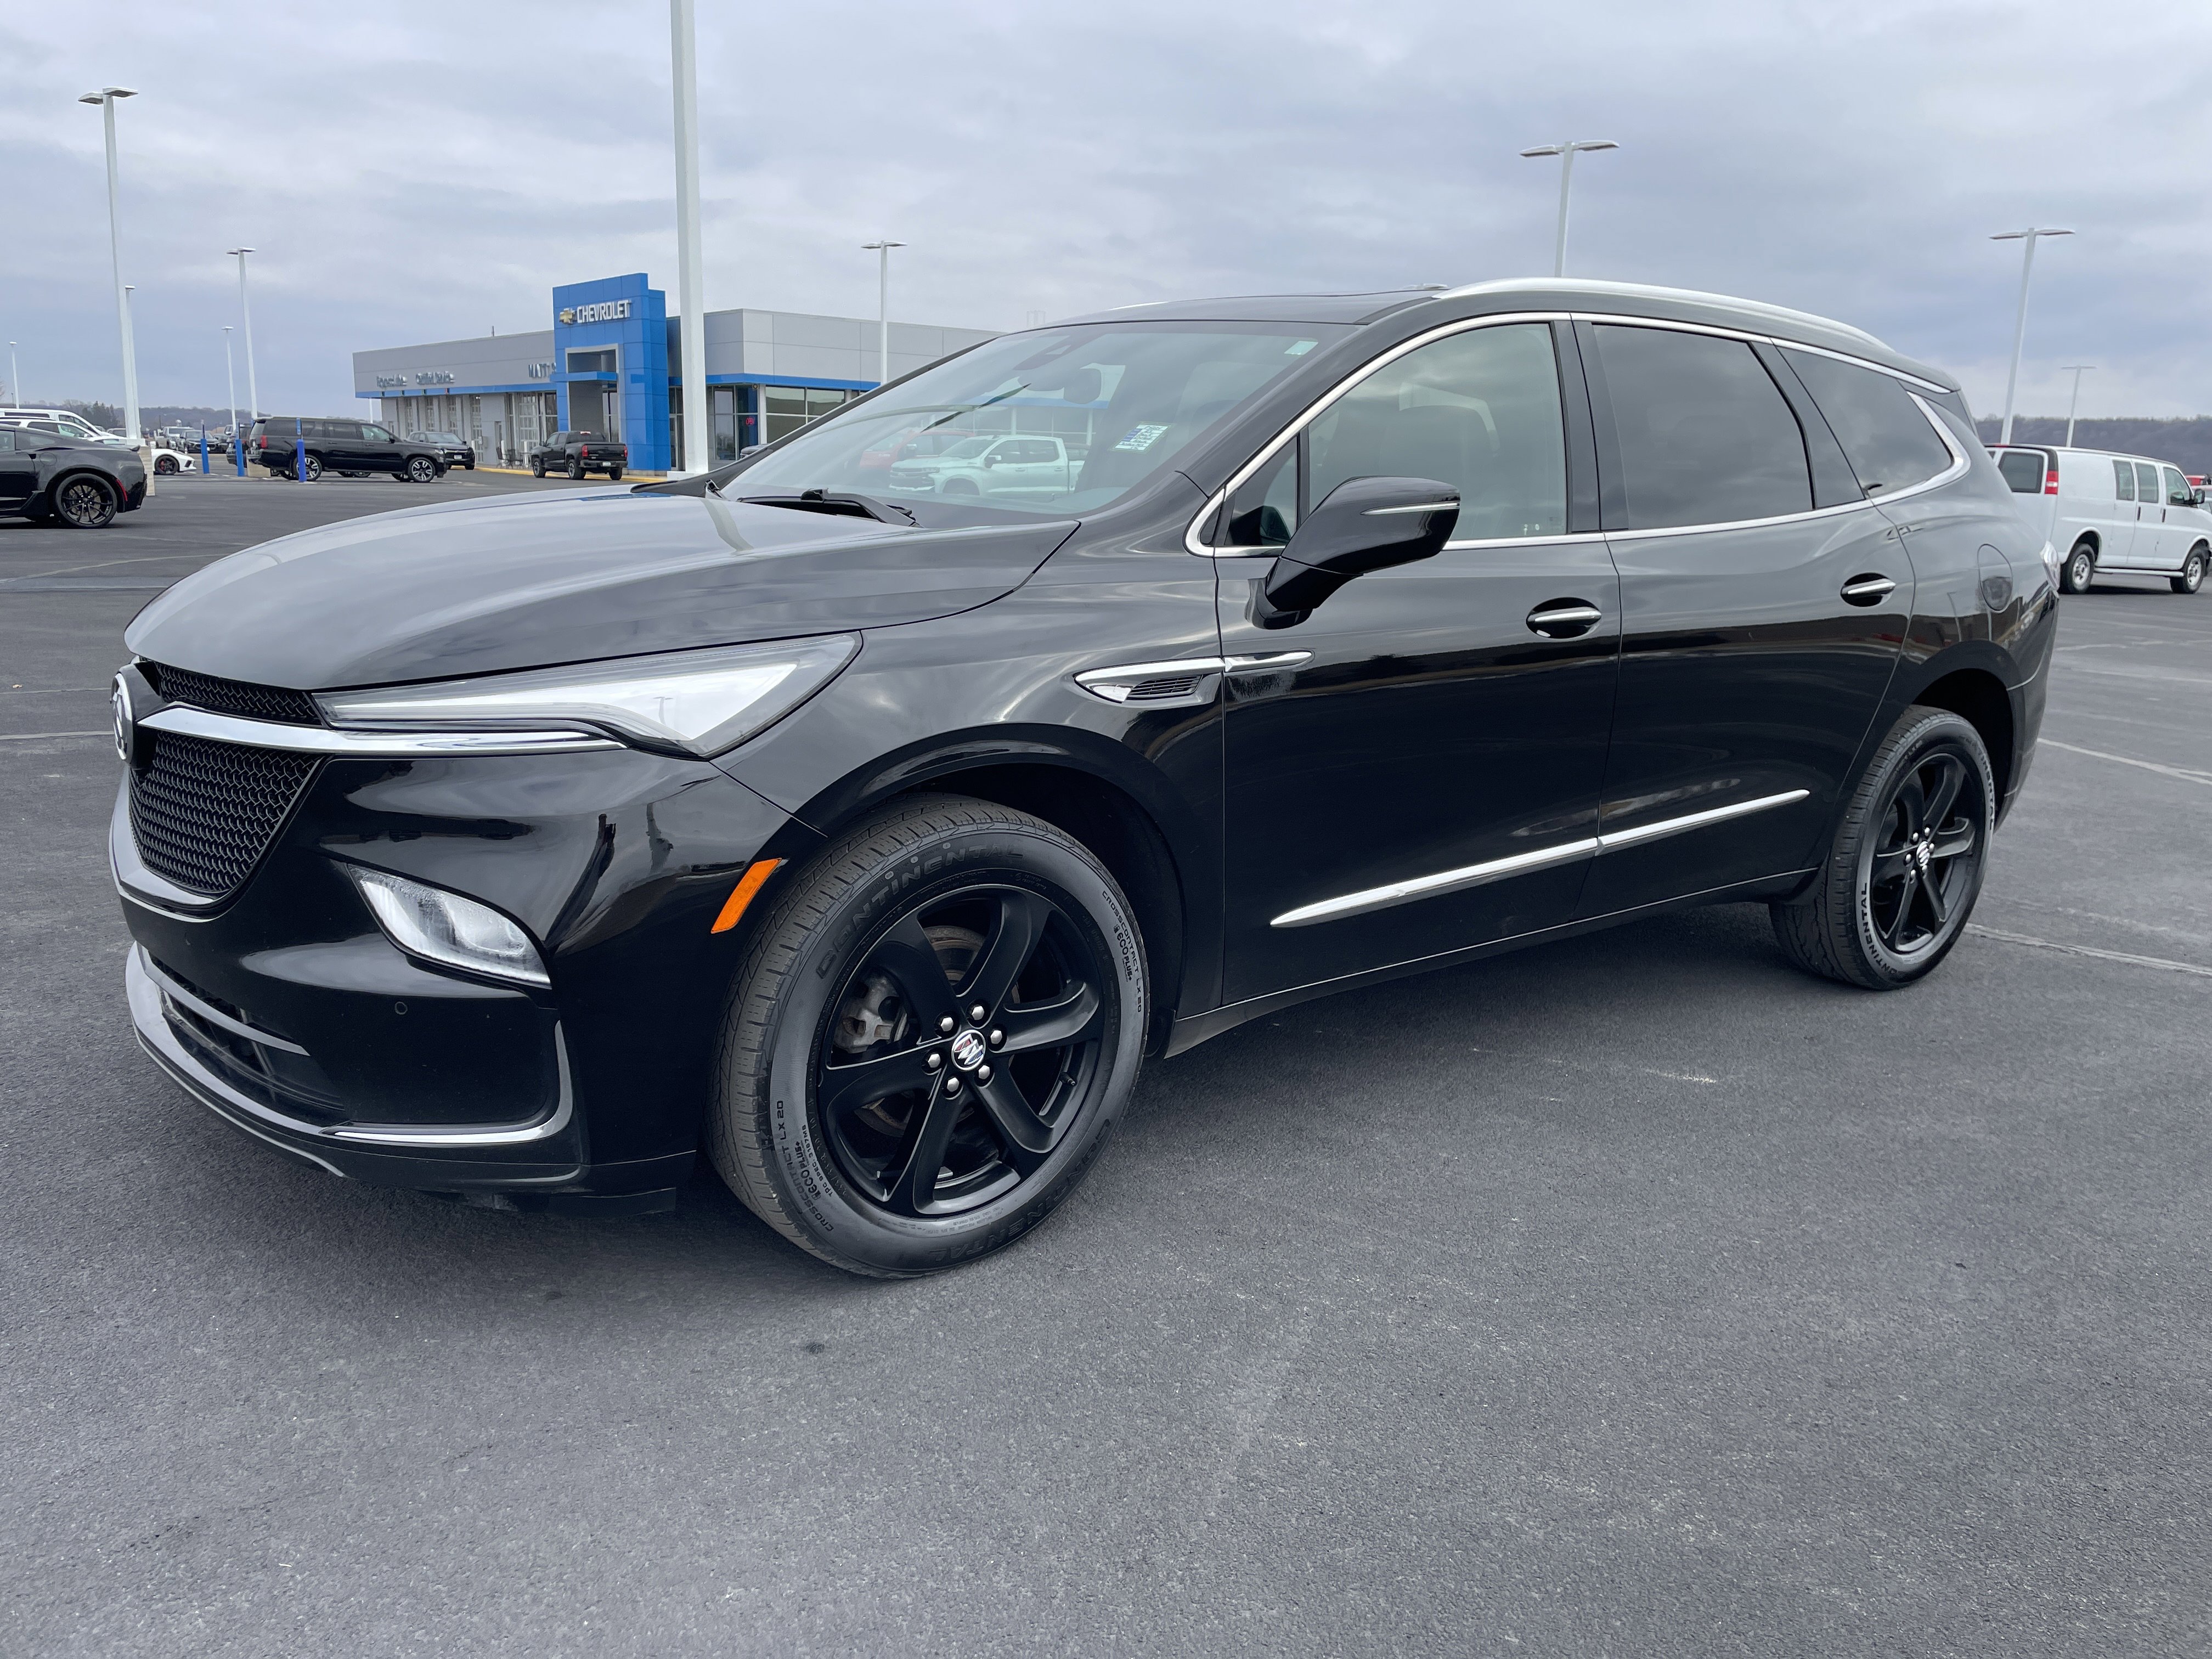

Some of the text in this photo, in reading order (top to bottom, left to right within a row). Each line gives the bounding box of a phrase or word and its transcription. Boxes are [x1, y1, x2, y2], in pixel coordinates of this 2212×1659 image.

[577, 300, 631, 323] CHEVROLET
[816, 843, 1023, 979] CONTINENTAL
[1102, 891, 1139, 973] CROSSCONTACT
[1136, 978, 1141, 994] LX
[1861, 883, 1898, 974] ONTINENTAL
[777, 1101, 784, 1119] 20
[778, 1122, 787, 1140] LX
[782, 1146, 834, 1232] CROSSCONTACT
